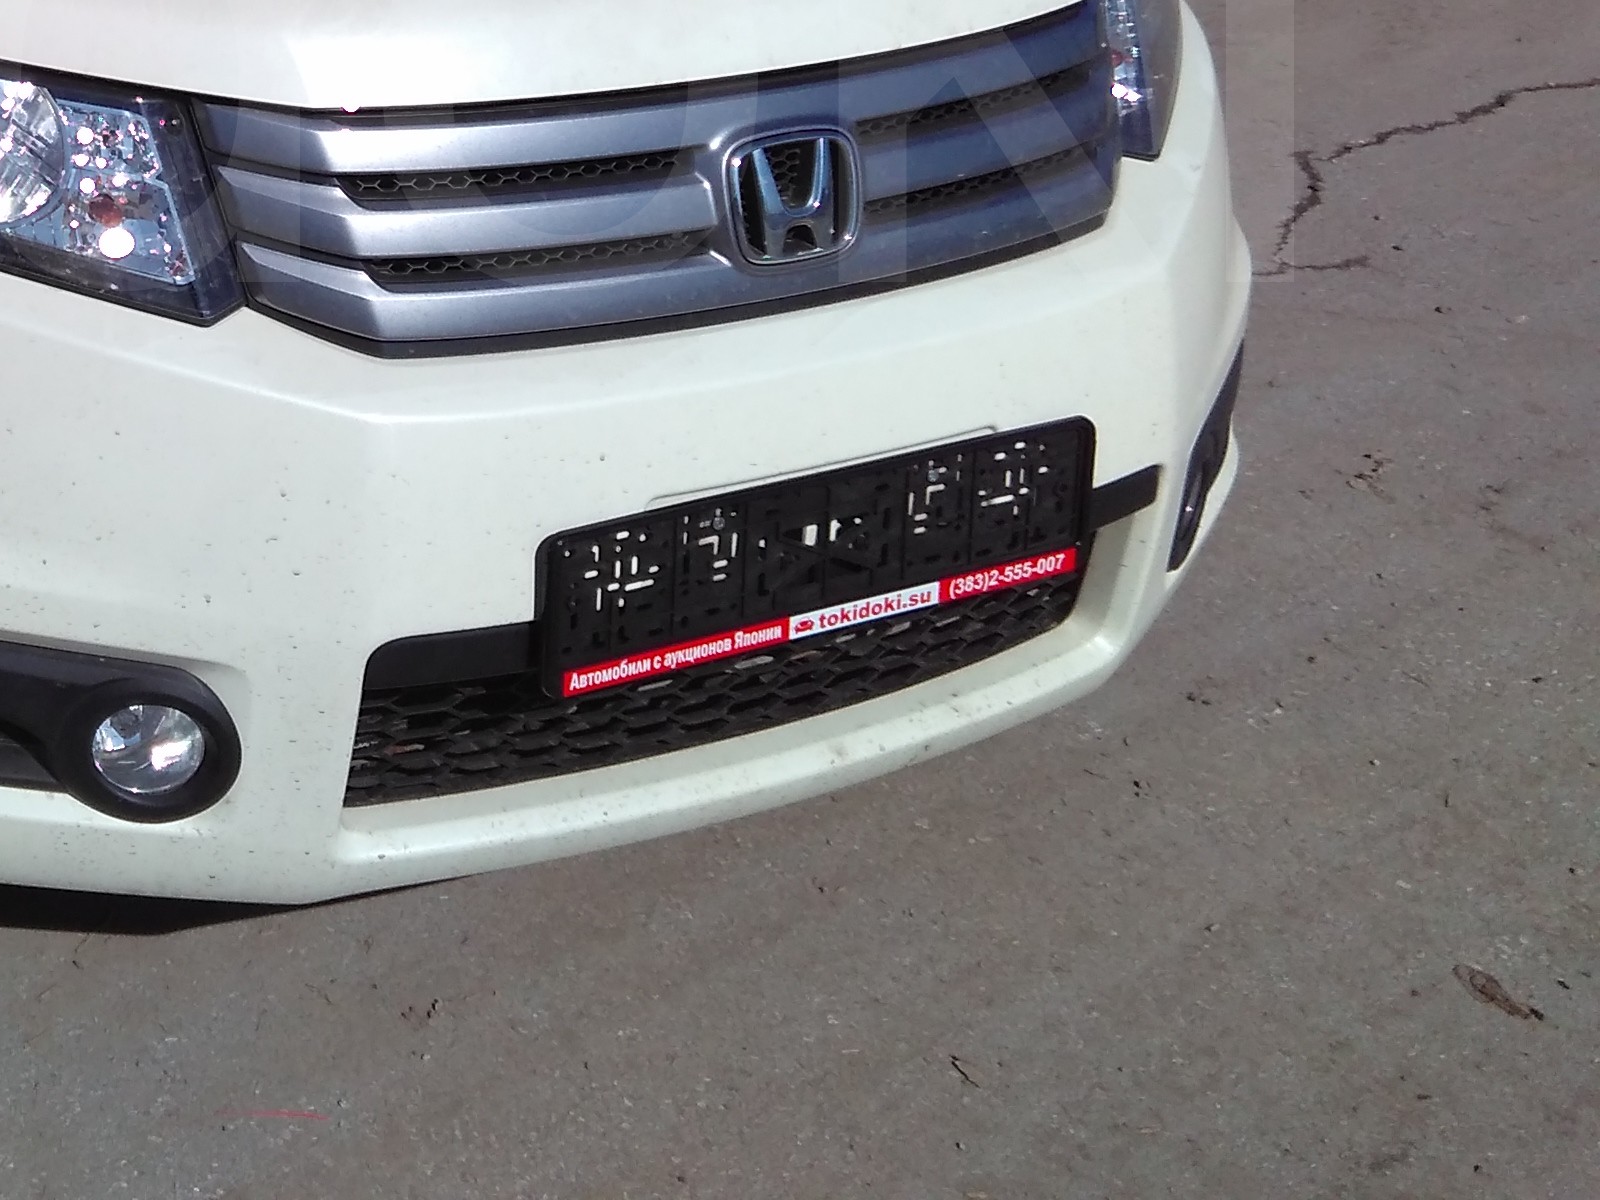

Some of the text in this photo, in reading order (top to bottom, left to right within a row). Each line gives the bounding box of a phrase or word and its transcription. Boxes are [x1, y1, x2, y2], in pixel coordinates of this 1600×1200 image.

[948, 553, 1066, 600] (383)2-555-007
[818, 588, 933, 629] tokidoki.su
[569, 653, 651, 690] Автомобили
[663, 641, 732, 670] аукционов
[733, 624, 783, 650] Японии
